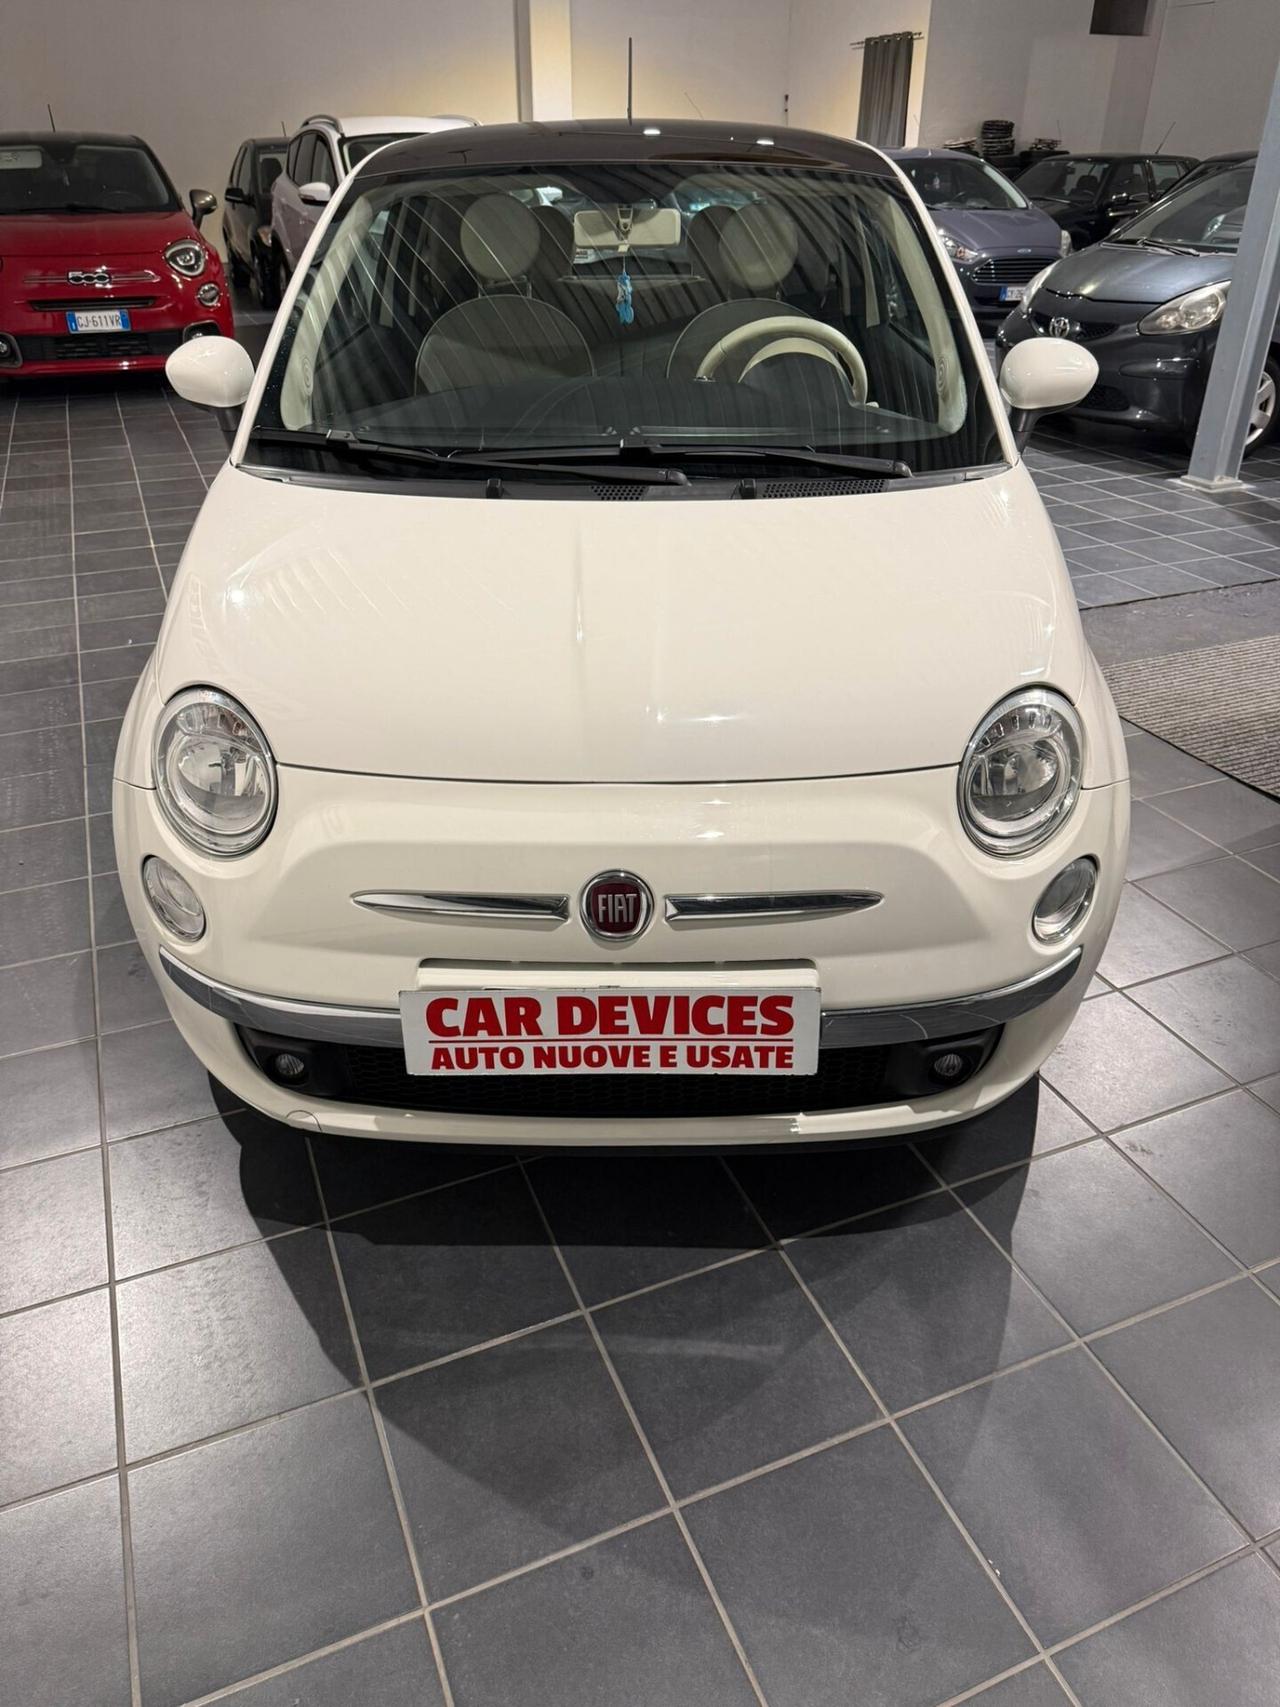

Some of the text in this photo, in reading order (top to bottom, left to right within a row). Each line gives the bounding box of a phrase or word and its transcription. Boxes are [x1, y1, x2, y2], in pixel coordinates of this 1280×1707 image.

[597, 893, 638, 923] FIAT
[425, 994, 795, 1038] CAR DEVICES
[431, 1045, 794, 1070] AUTO NUOVE E USATE
